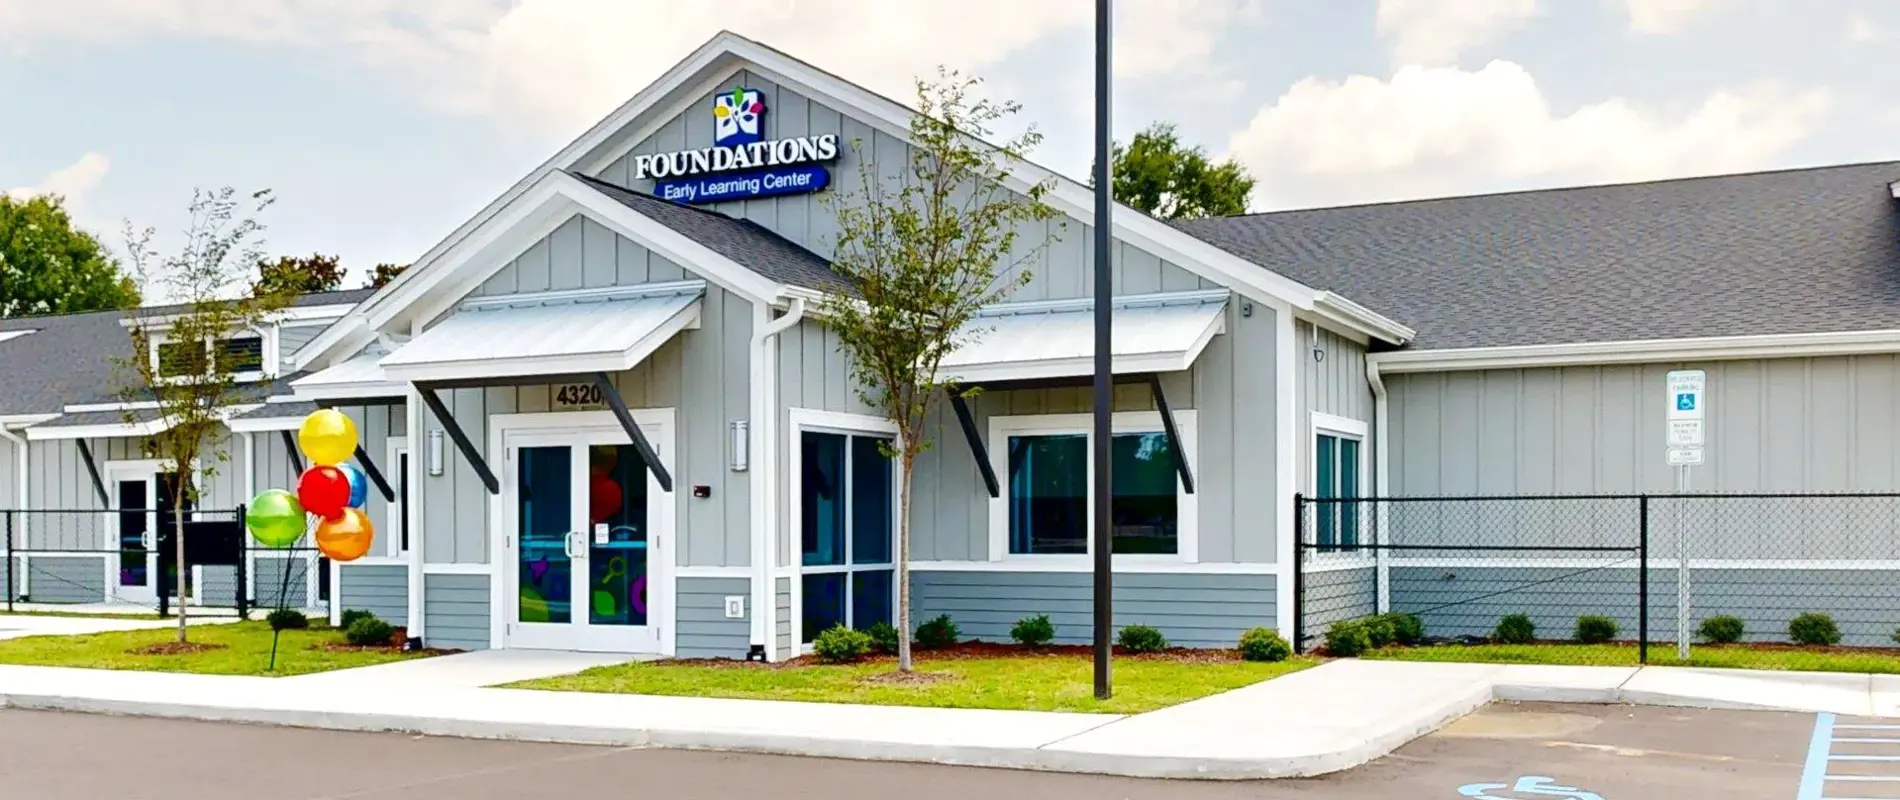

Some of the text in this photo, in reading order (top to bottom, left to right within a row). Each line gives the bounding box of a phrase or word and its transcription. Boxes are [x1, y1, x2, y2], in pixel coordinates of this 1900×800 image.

[634, 134, 837, 179] FOUNDATIONS
[664, 172, 812, 201] Early Learning Center
[556, 384, 605, 405] 4320
